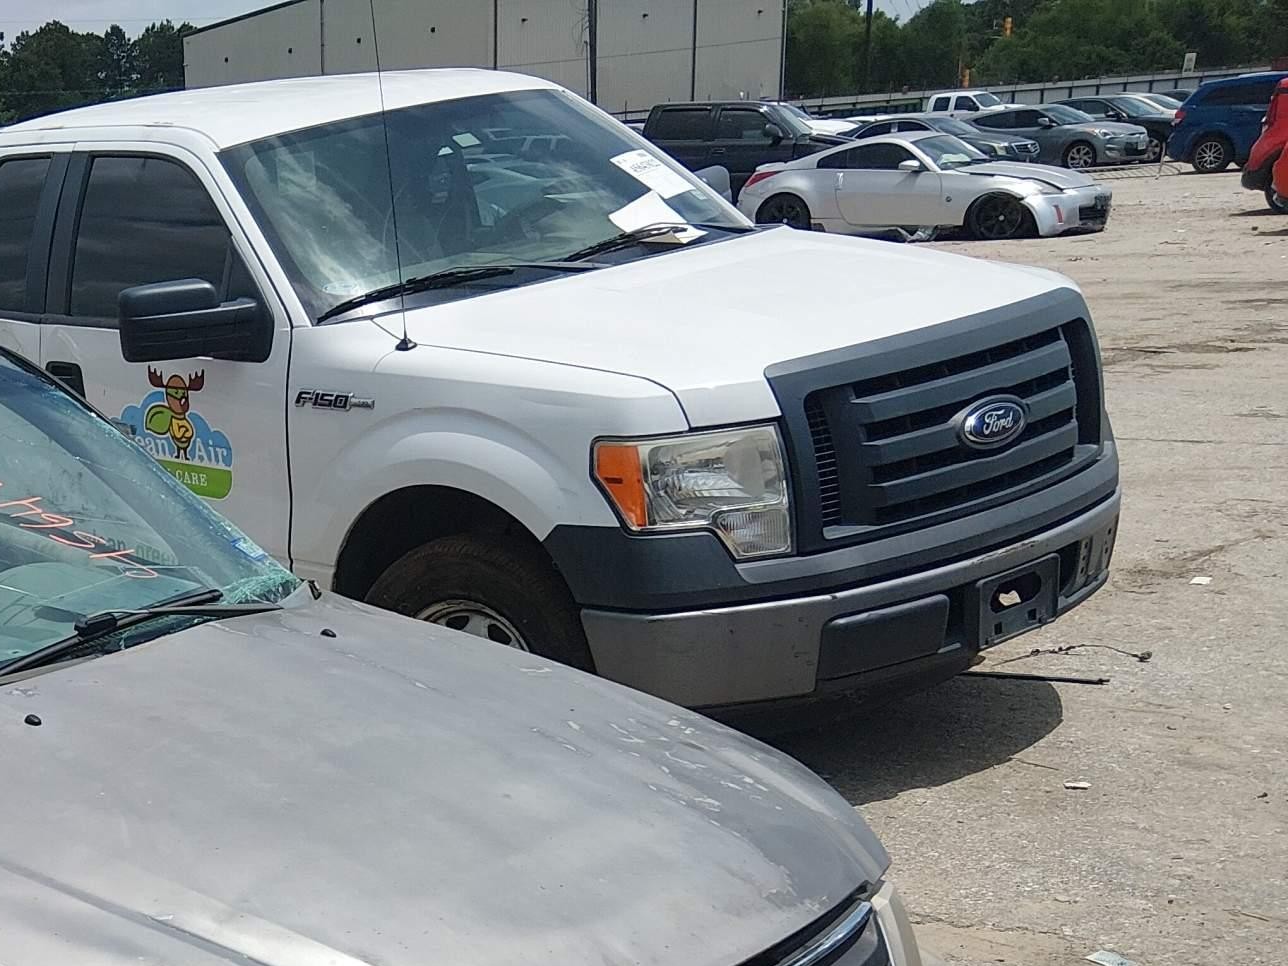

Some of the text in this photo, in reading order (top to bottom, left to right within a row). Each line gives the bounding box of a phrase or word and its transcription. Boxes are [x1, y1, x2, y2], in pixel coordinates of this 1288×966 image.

[983, 408, 1014, 434] Ford
[136, 436, 228, 467] ean Air
[175, 470, 208, 487] CARE
